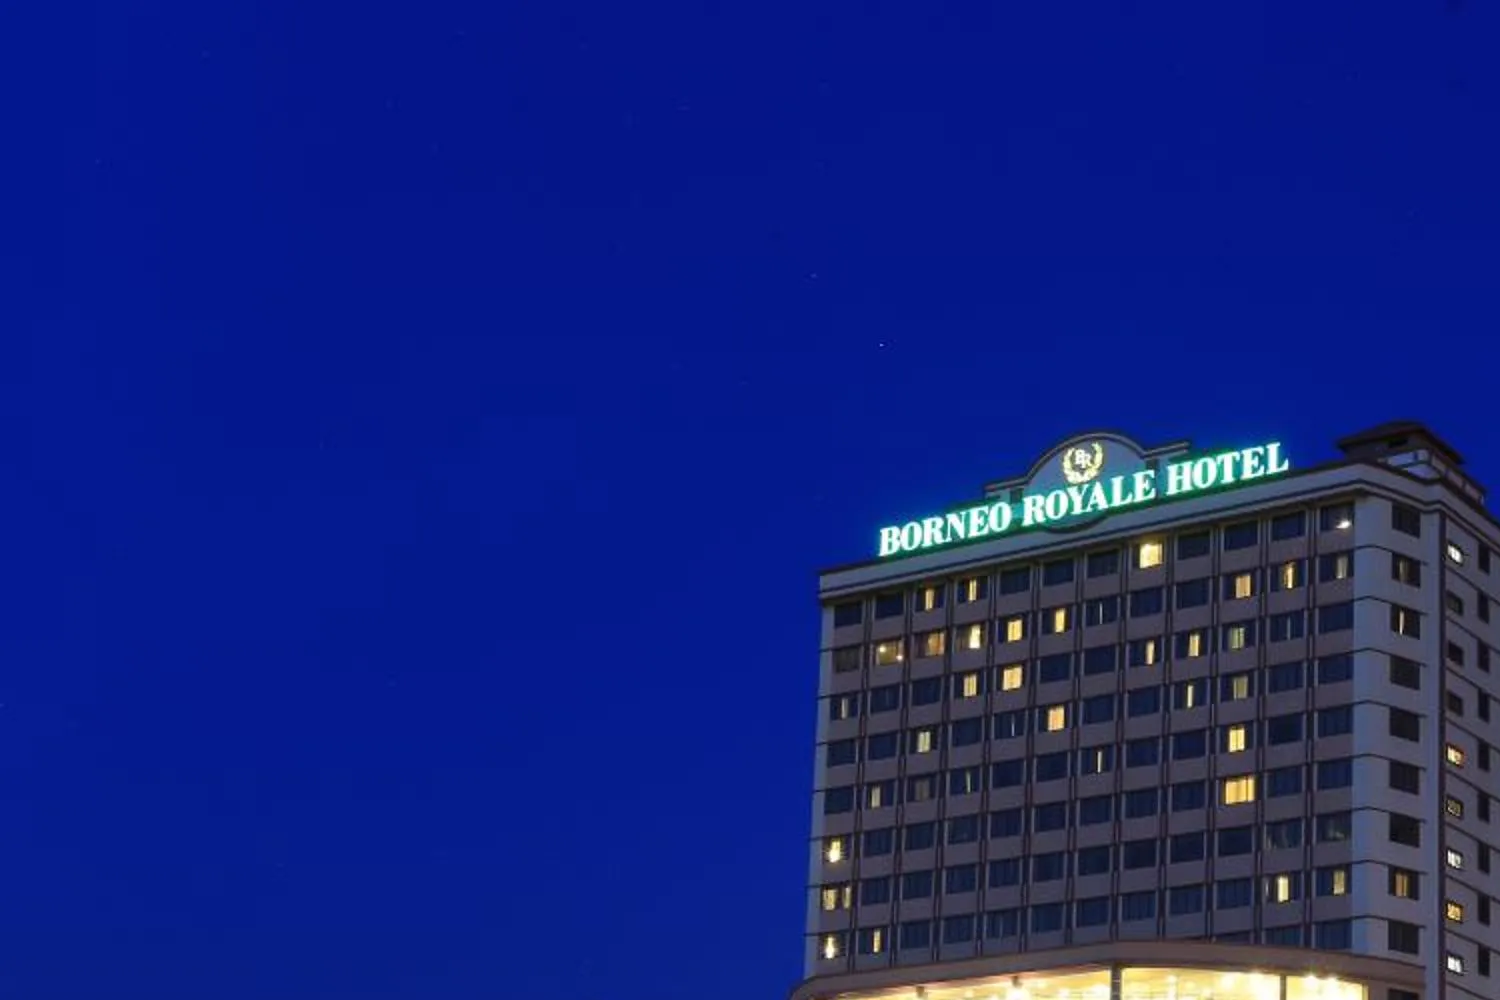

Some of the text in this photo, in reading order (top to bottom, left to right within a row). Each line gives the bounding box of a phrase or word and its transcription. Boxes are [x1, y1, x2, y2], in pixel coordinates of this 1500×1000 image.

[879, 441, 1290, 557] BORNEO ROYALE HOTEL
